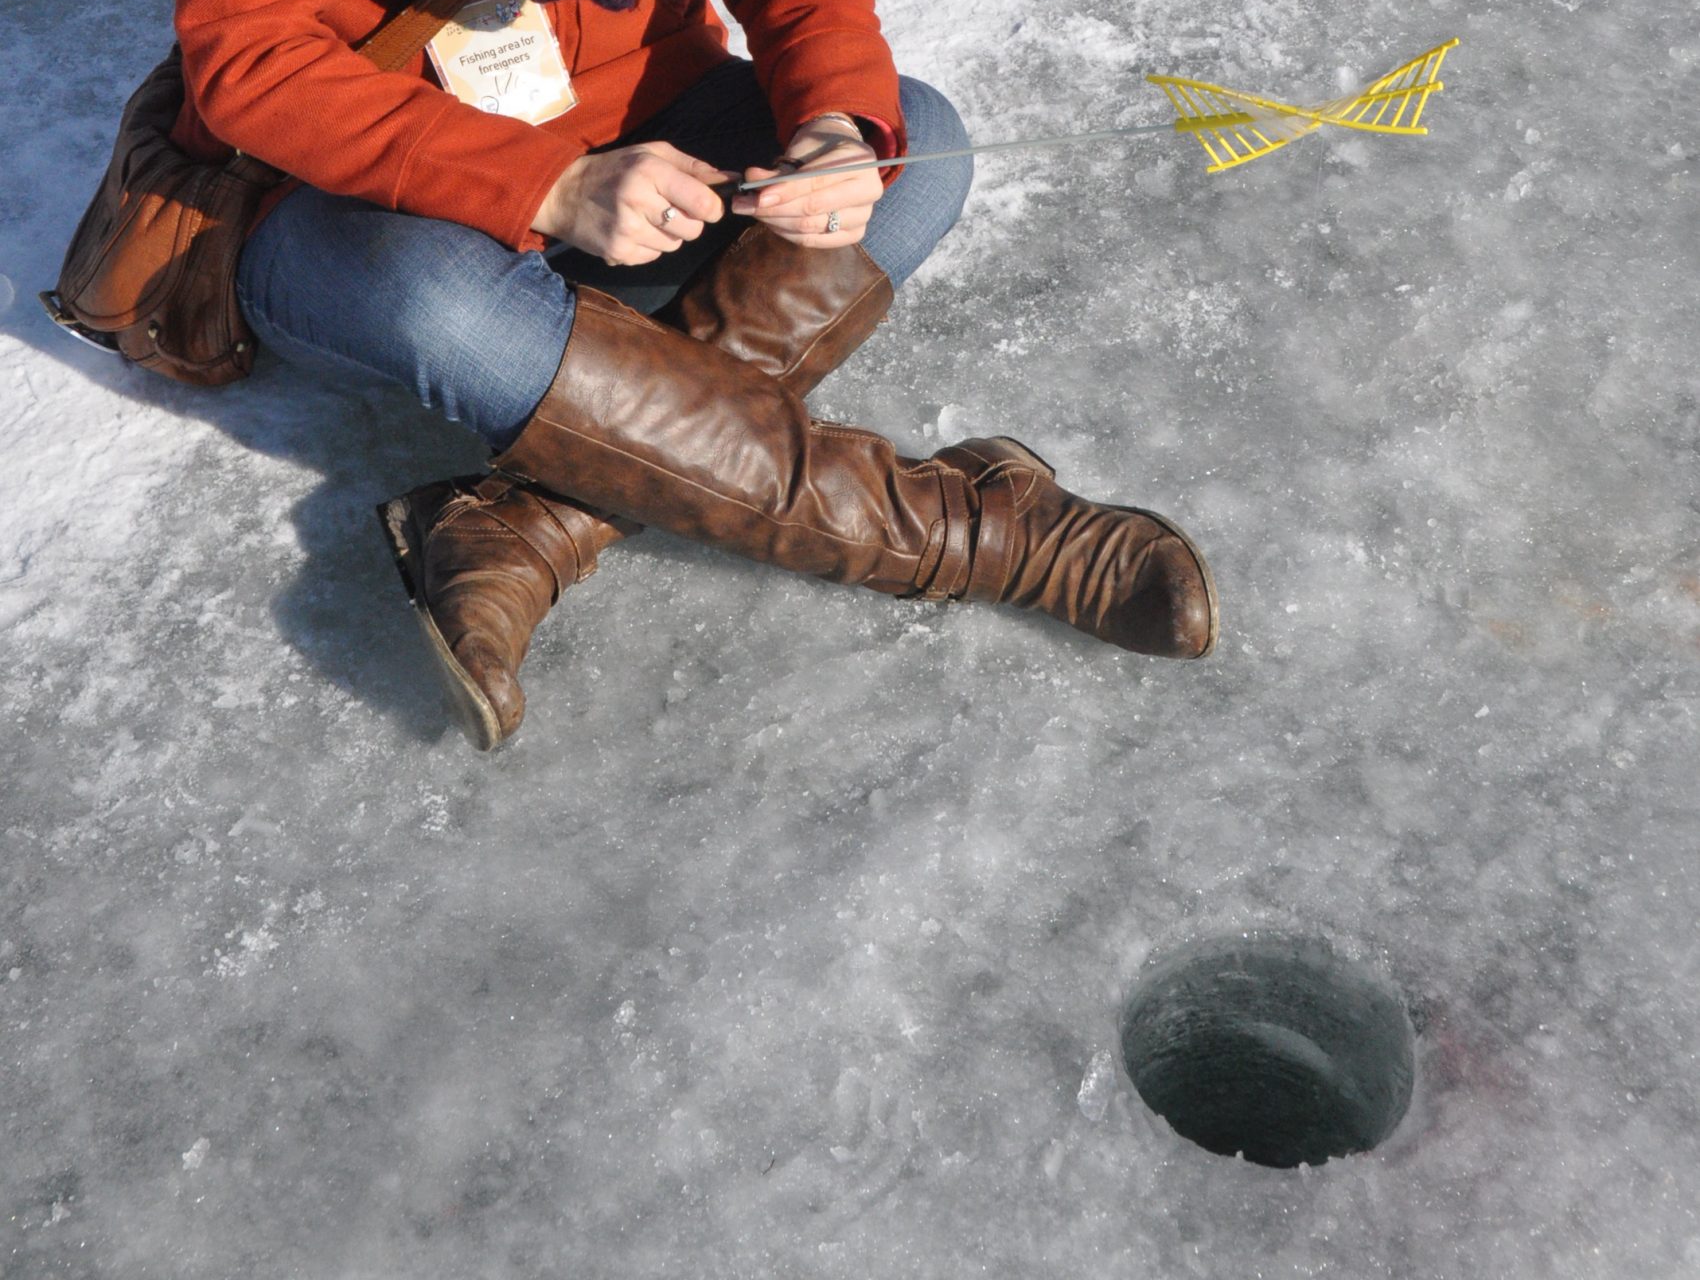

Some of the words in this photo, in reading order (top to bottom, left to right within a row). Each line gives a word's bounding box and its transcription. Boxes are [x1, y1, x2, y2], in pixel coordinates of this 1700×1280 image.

[459, 48, 497, 67] Fishing
[498, 40, 521, 54] area
[520, 35, 535, 47] for
[478, 52, 531, 75] foreigners
